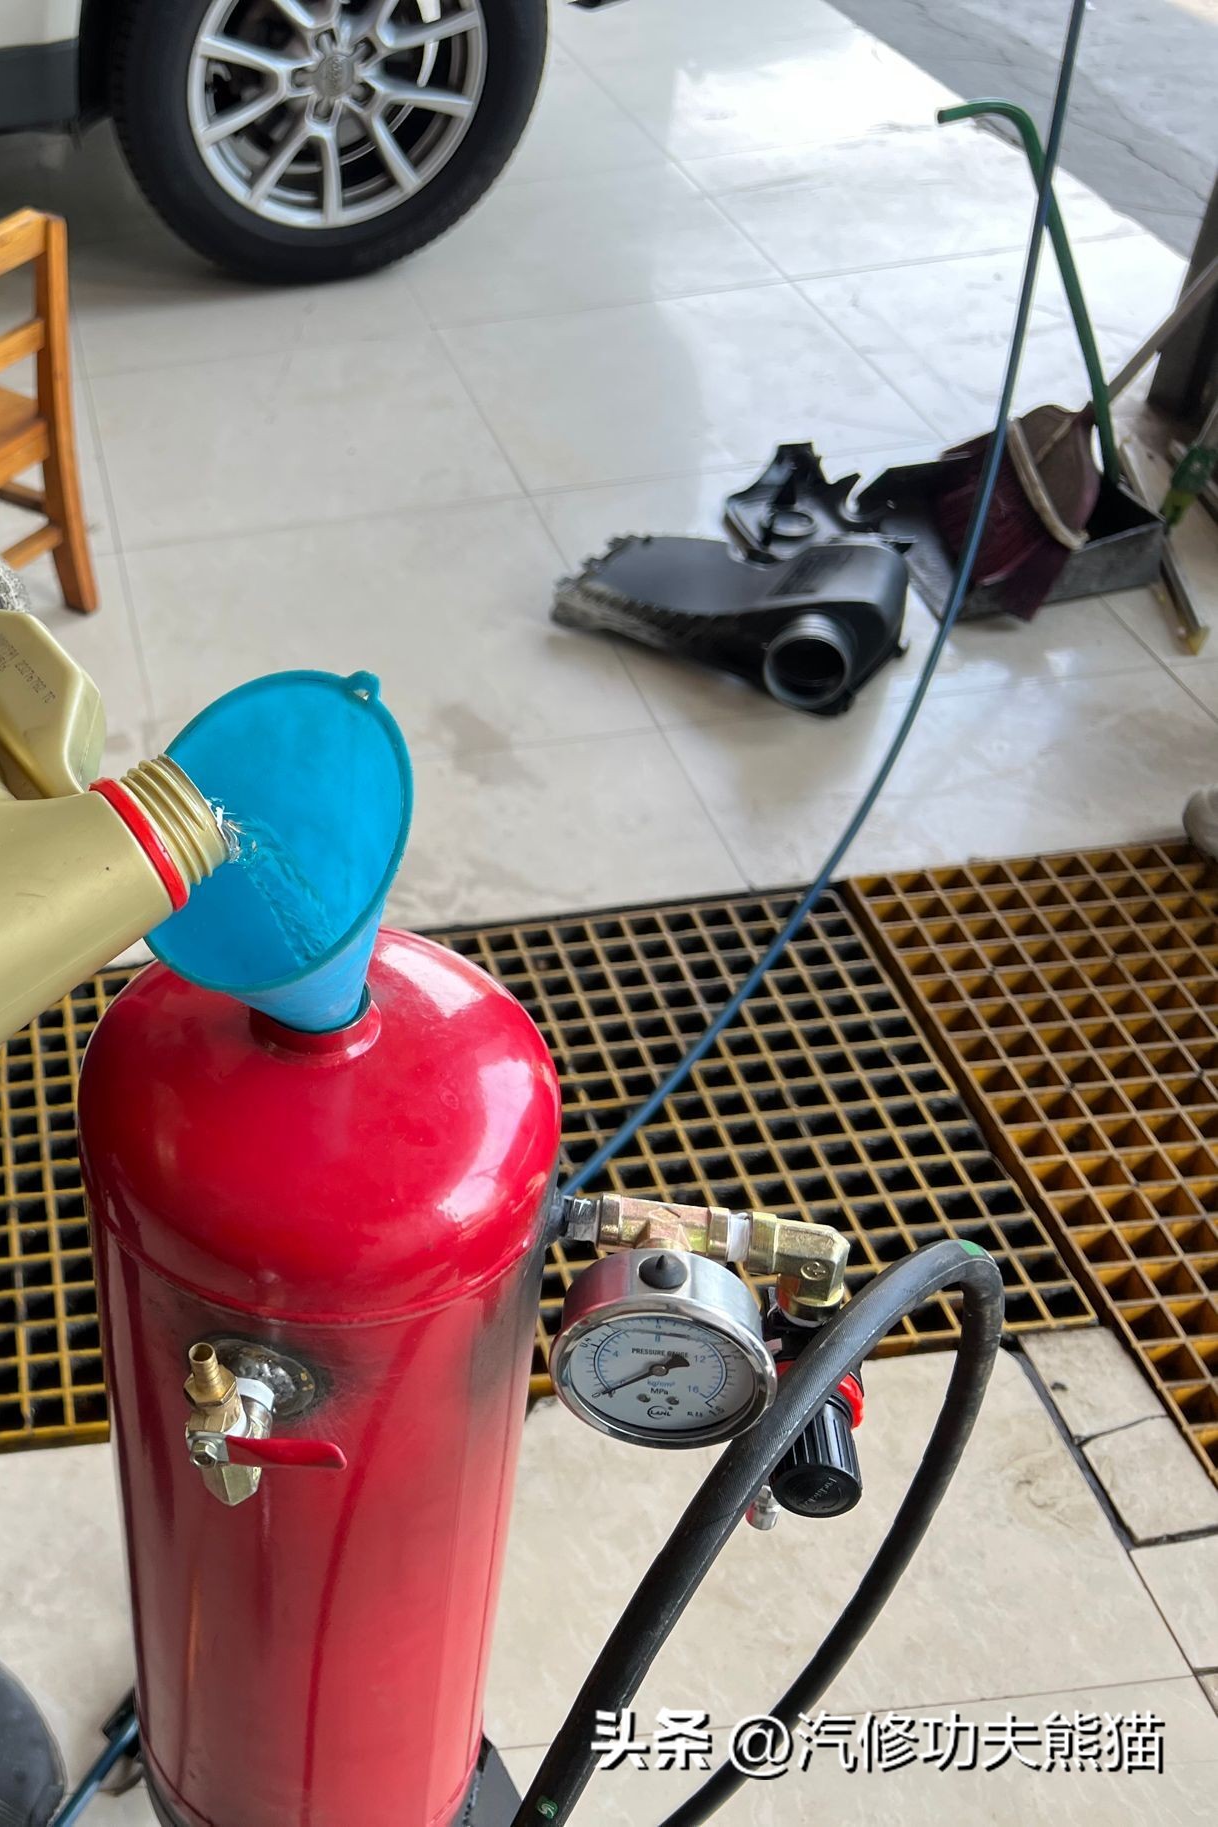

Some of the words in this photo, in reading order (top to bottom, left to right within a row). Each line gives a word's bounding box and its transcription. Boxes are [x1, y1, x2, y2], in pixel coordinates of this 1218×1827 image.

[631, 1347, 666, 1357] PRESSURE
[694, 1354, 707, 1363] 12
[650, 1387, 670, 1396] MPa
[687, 1384, 700, 1394] 16
